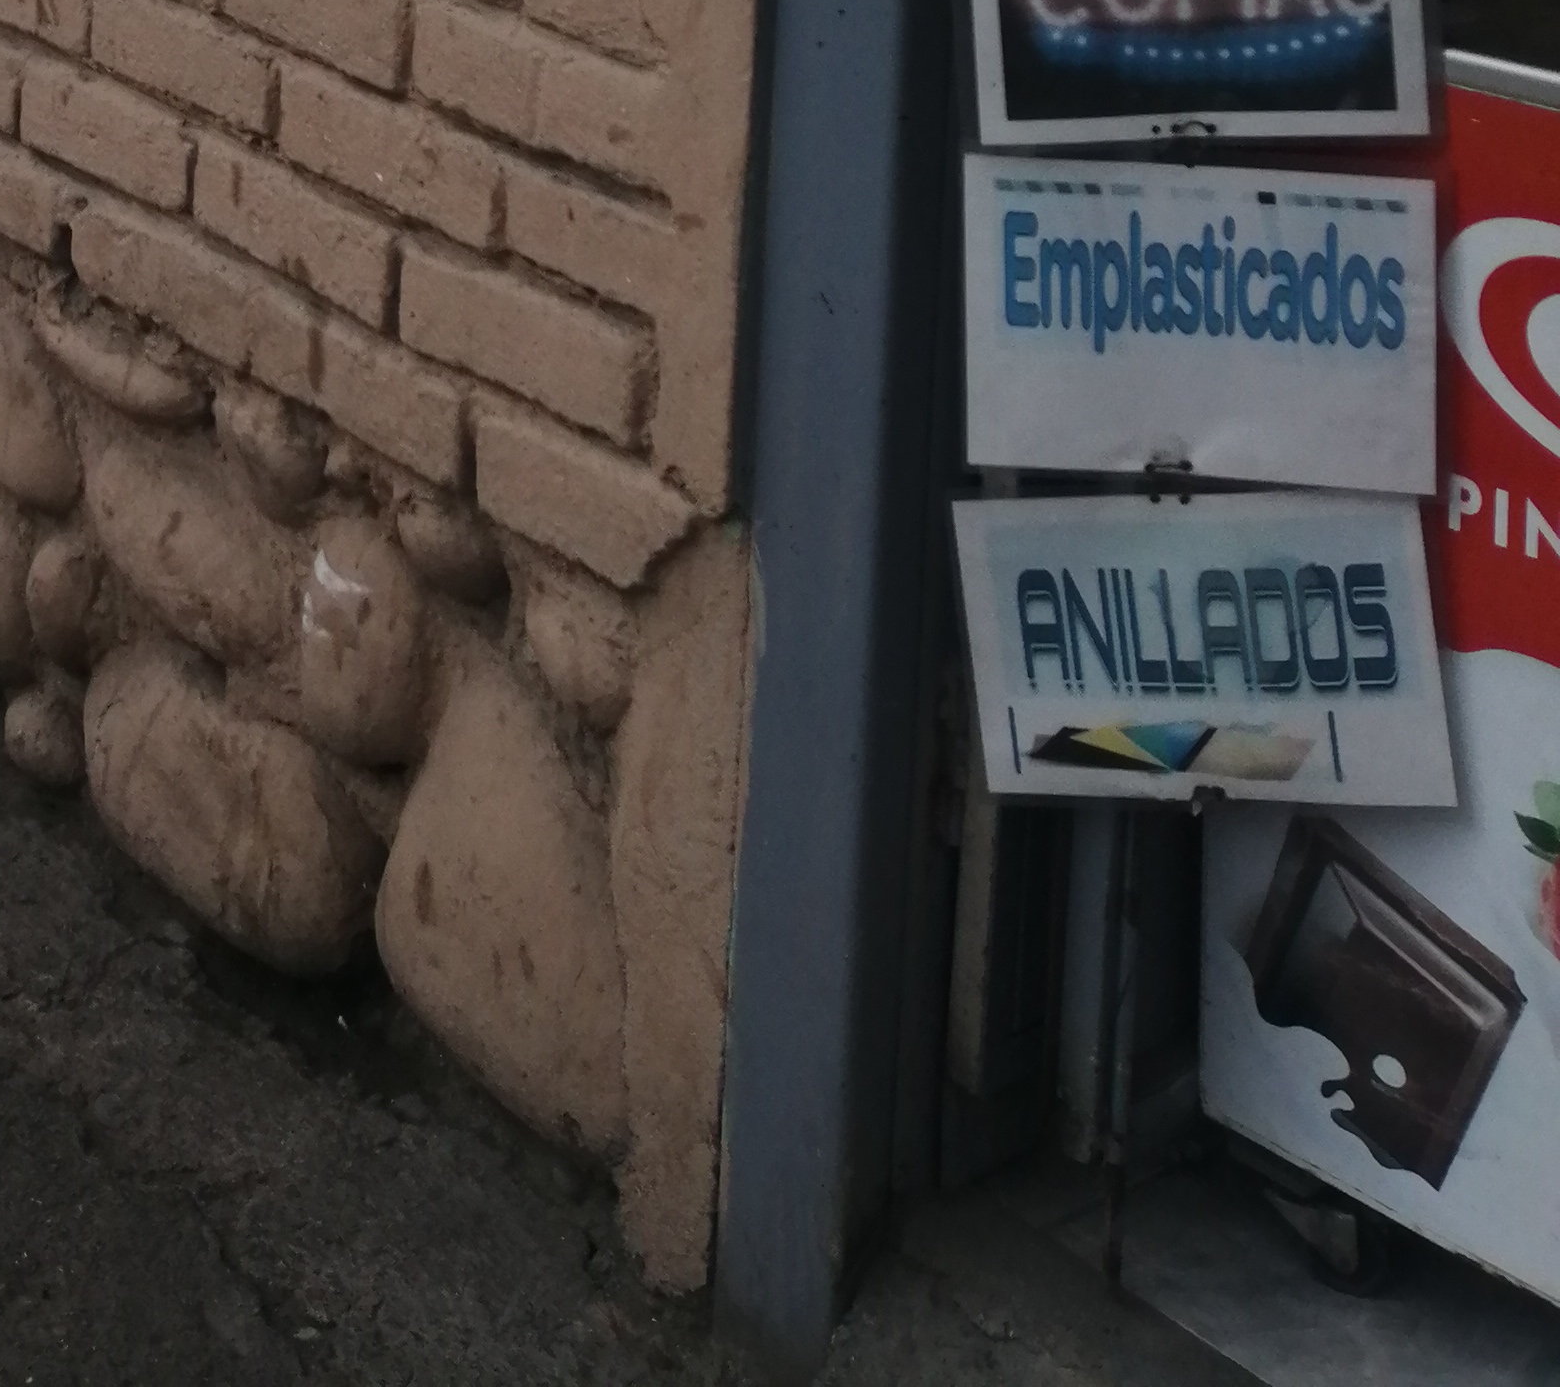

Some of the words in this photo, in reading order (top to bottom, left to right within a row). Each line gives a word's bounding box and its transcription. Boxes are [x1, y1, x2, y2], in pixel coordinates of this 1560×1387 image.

[1002, 209, 1407, 355] Emplasticados
[1448, 473, 1560, 559] PIN
[1016, 562, 1399, 694] ANILLADOS
